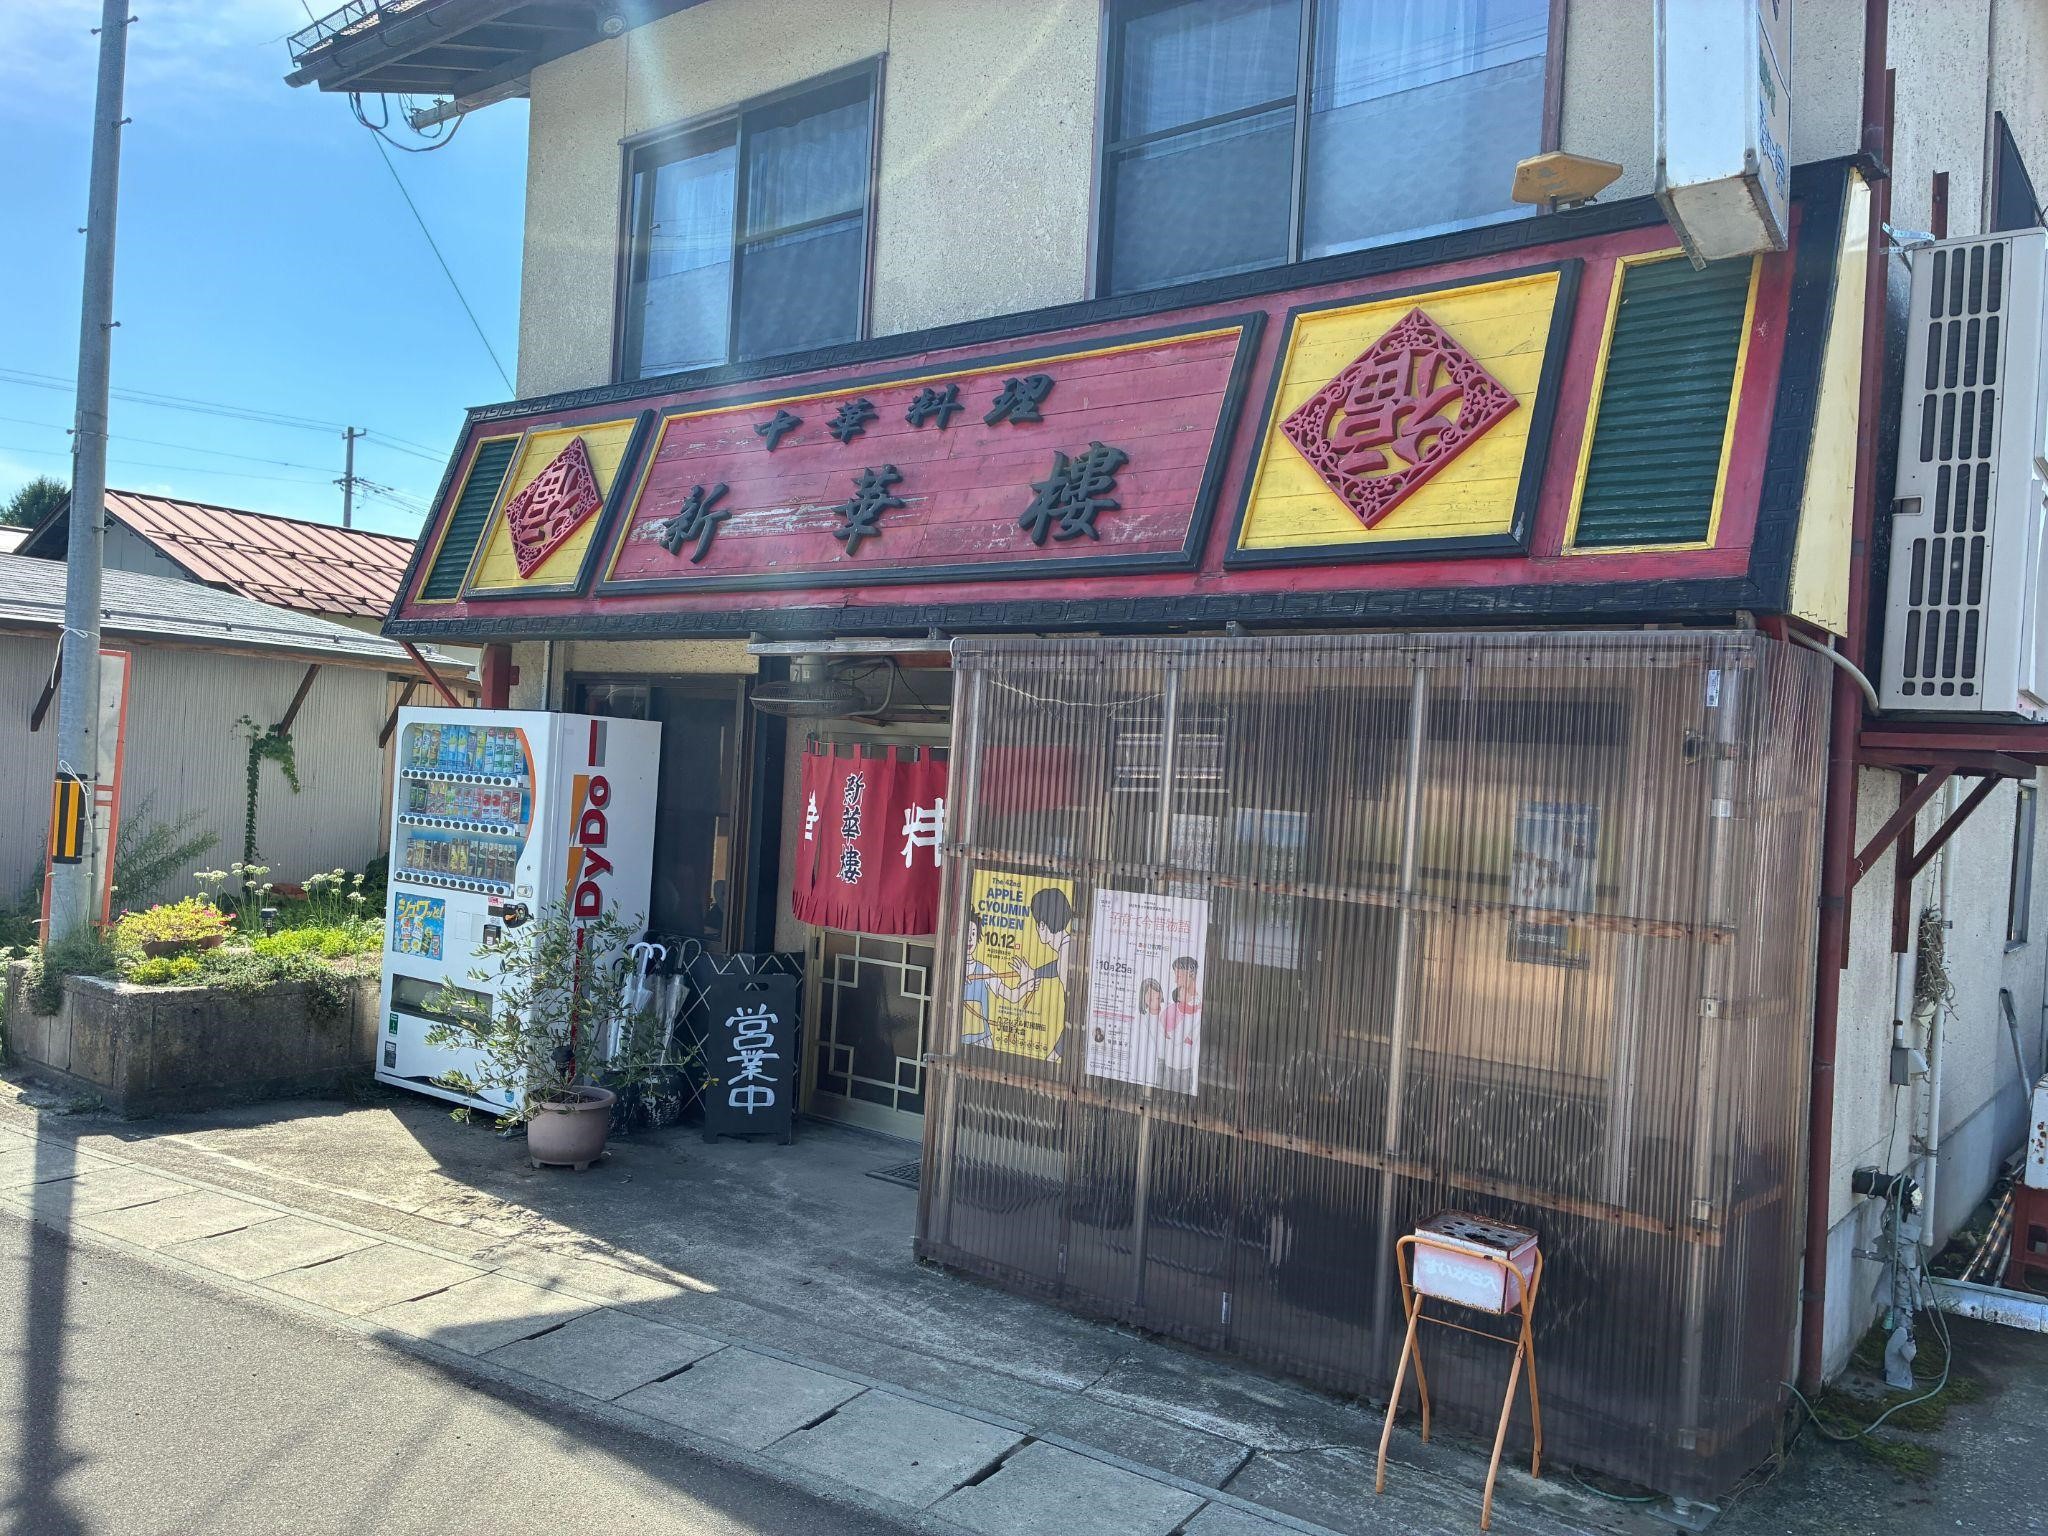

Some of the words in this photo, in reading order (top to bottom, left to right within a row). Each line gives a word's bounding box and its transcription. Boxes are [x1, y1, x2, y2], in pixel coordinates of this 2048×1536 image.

[753, 373, 1056, 452] 中華料理
[575, 775, 612, 918] DyDo
[978, 900, 1030, 918] CYOUMIN
[986, 887, 1023, 902] APPLE
[981, 914, 1024, 931] EKIDEN
[725, 1003, 780, 1115] 営業中
